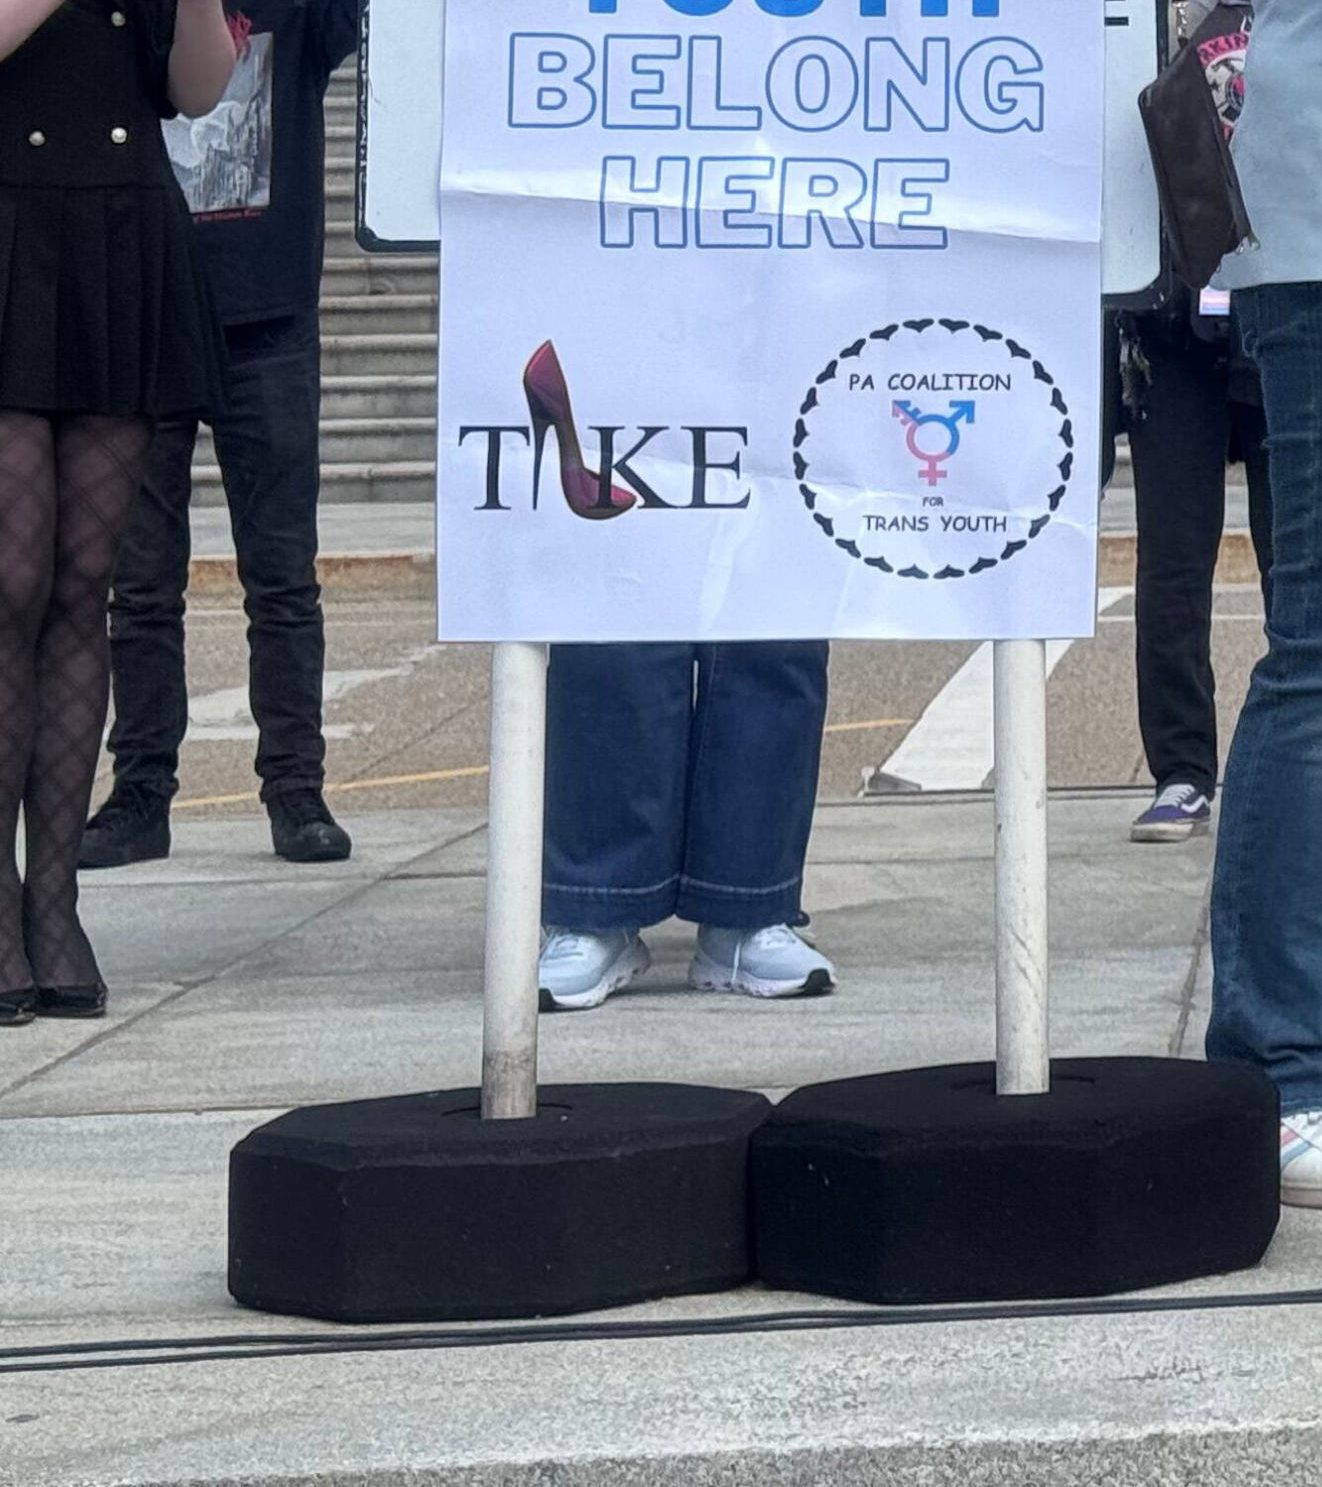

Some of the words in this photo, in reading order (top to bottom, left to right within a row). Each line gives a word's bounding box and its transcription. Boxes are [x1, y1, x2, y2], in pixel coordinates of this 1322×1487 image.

[507, 32, 1045, 133] BELONG
[599, 155, 949, 251] HERE
[849, 373, 875, 391] PA
[887, 373, 1012, 391] COALITION
[922, 496, 944, 507] FOR
[863, 515, 930, 532] TRANS
[940, 515, 1007, 533] YOUTH
